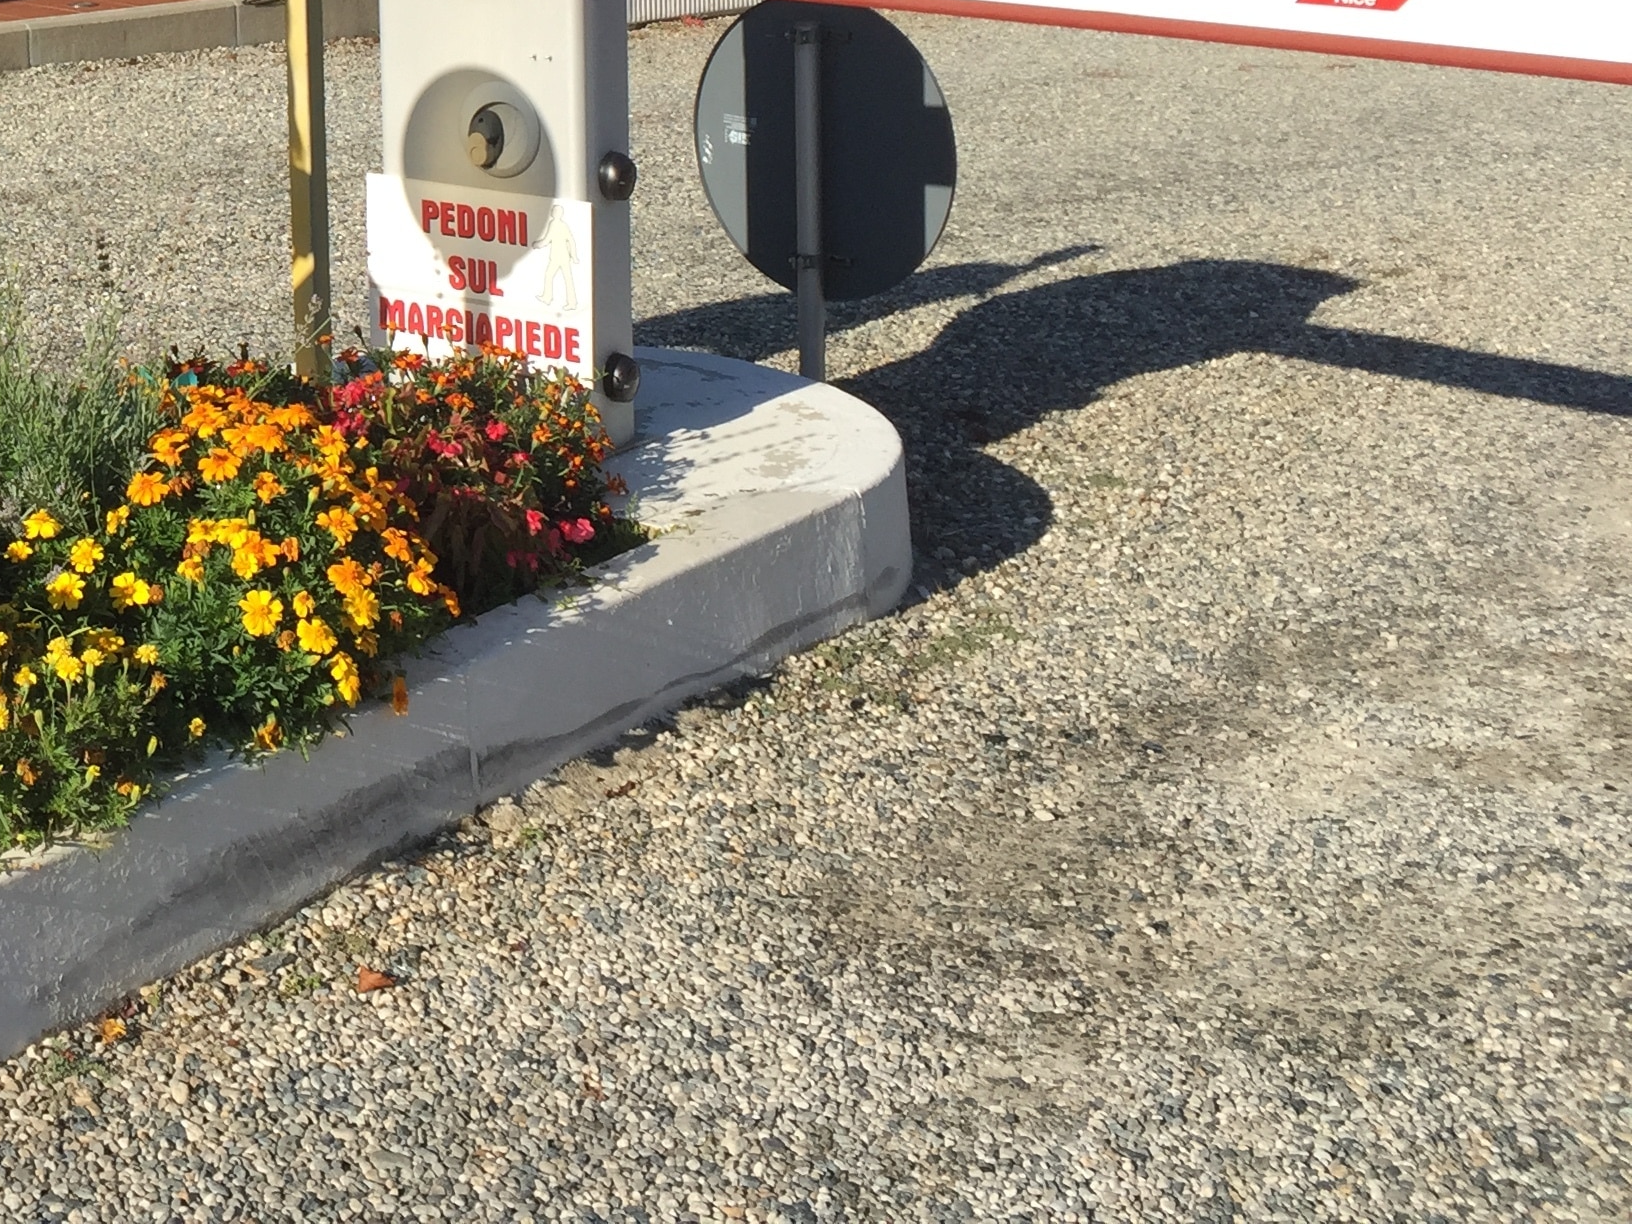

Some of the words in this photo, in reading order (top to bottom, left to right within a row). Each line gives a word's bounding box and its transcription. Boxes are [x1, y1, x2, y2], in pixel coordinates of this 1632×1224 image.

[421, 199, 528, 247] PEDONI
[448, 255, 504, 297] SUL
[379, 295, 581, 364] MARCIAPIEDE
